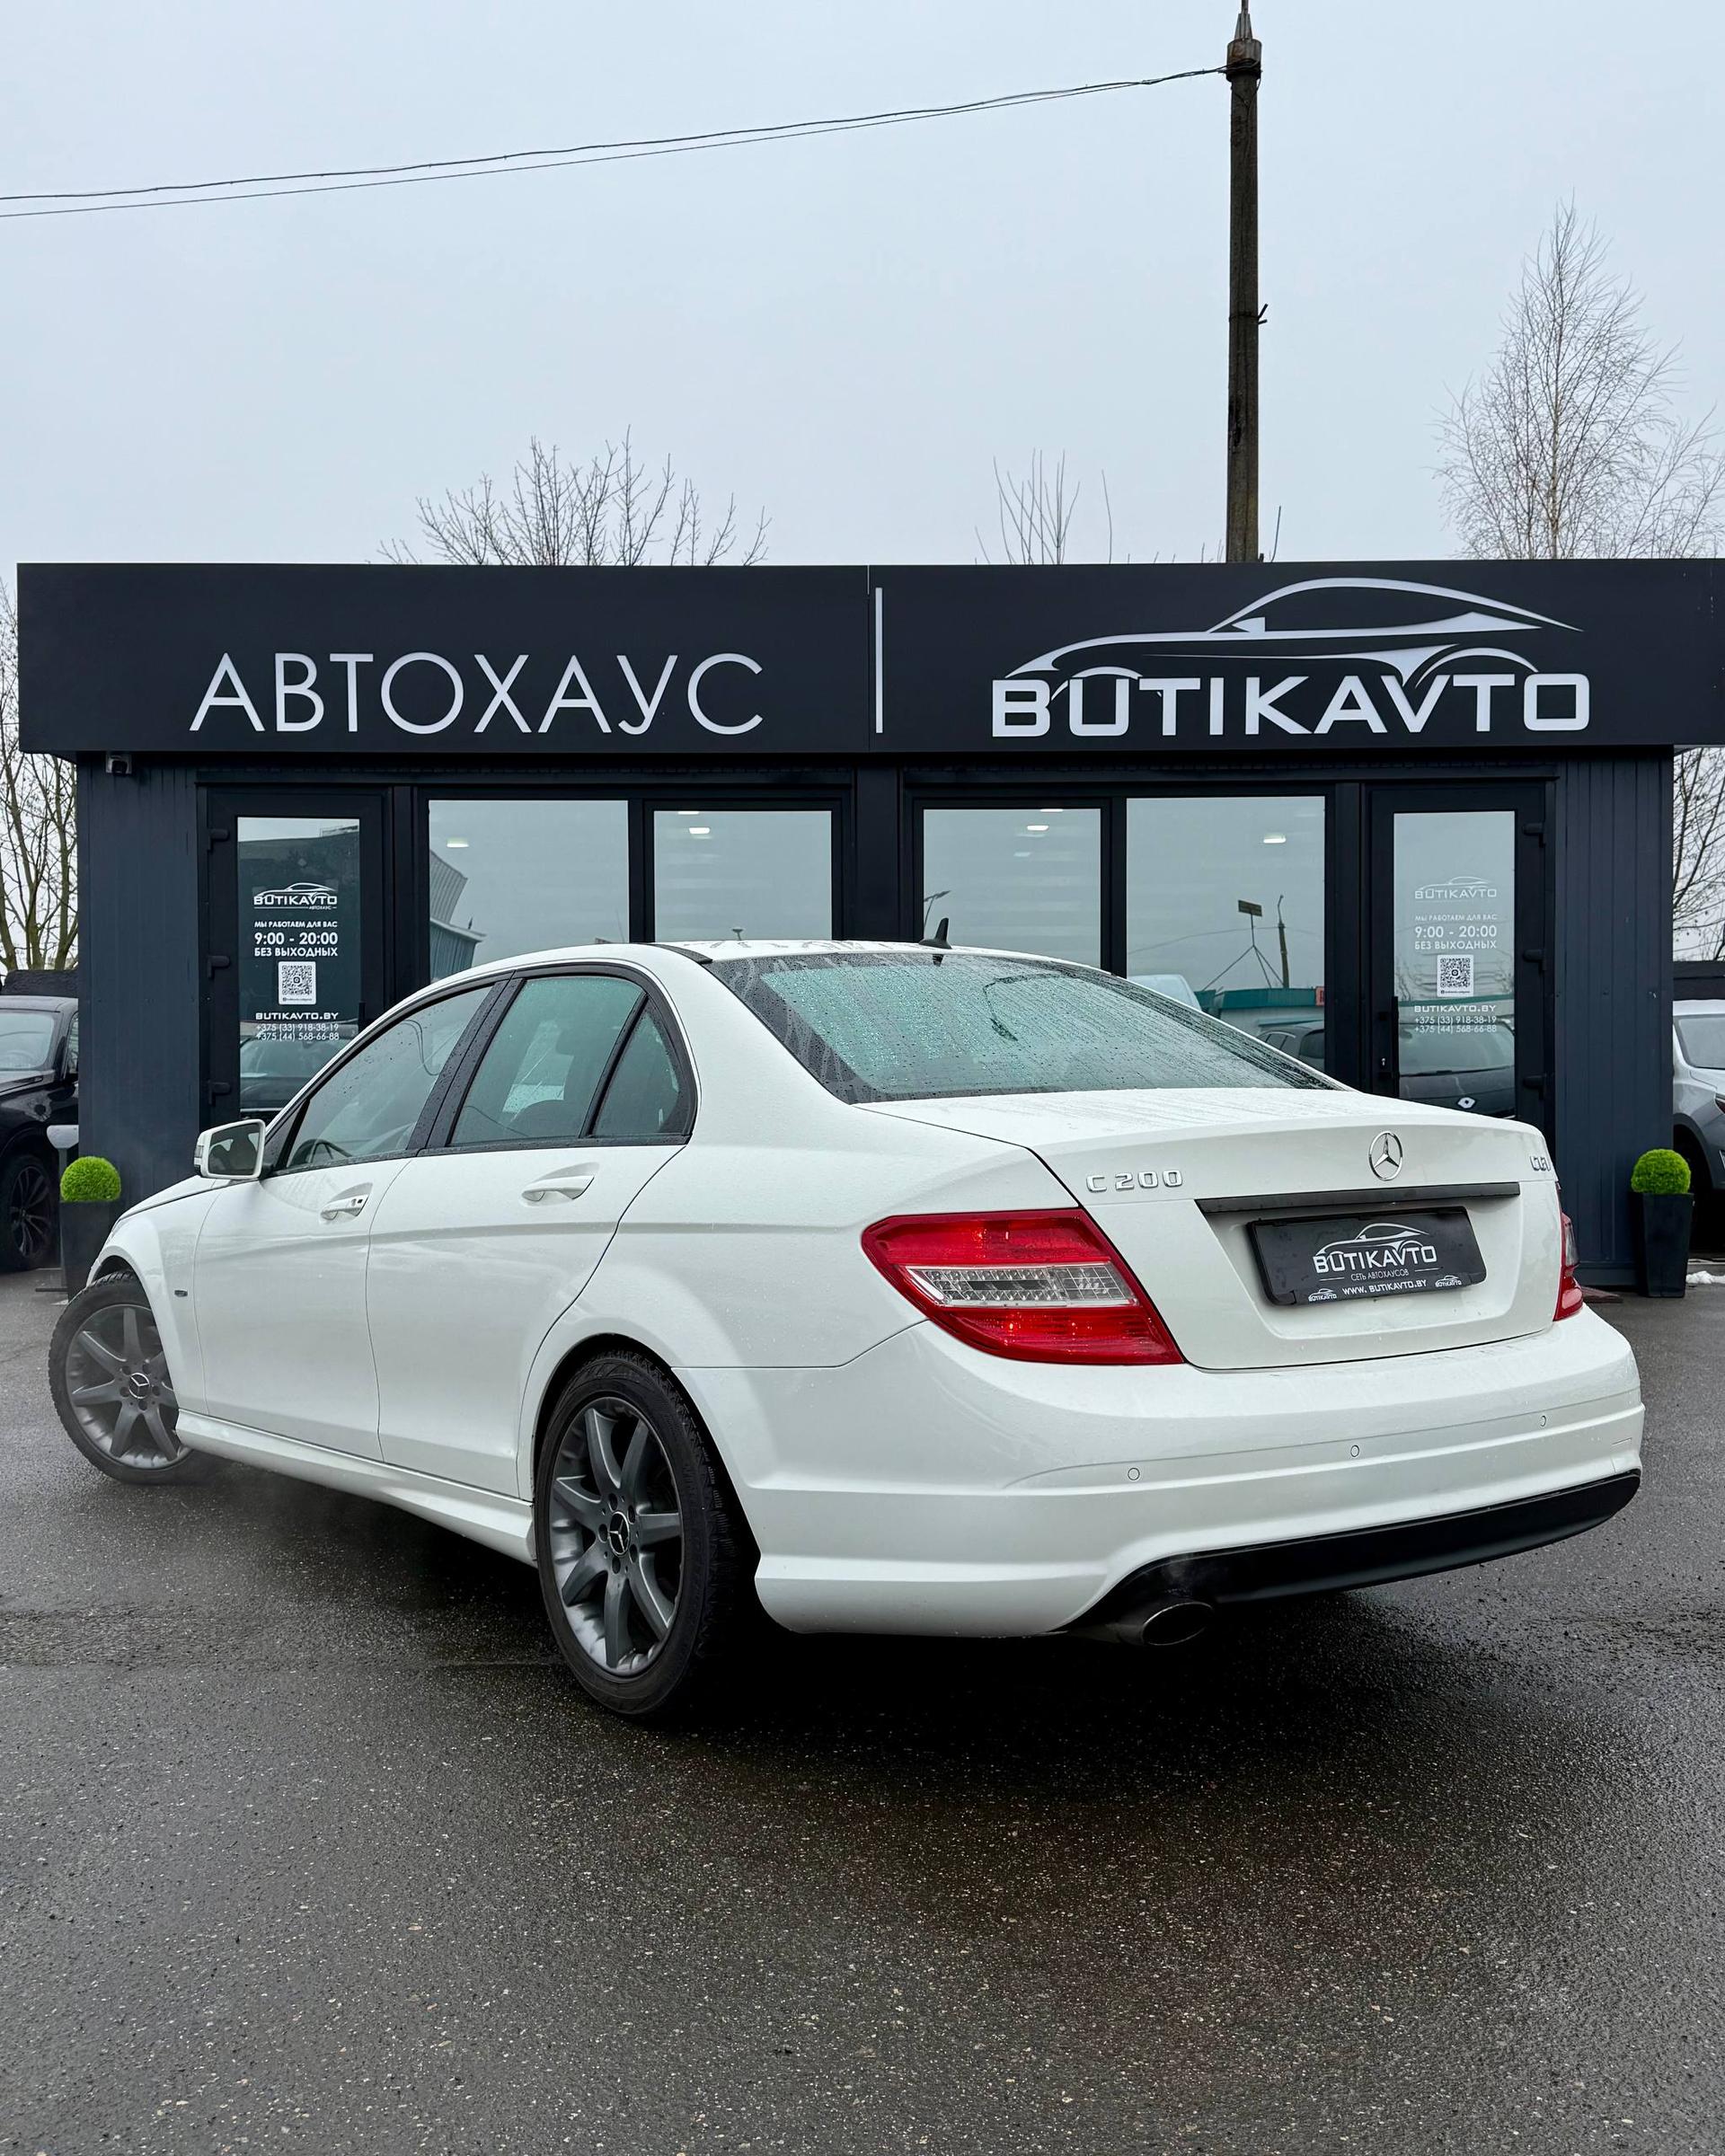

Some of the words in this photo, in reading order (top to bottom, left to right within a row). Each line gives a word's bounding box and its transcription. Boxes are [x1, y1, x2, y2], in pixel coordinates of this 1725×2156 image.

[190, 651, 764, 736] АВТОХАУС
[992, 672, 1589, 738] BUTIKAVTO
[1414, 888, 1497, 899] BUTIKAVTO
[253, 895, 338, 906] BUTIKAVTO
[1466, 914, 1482, 922] ДЛЯ
[306, 921, 322, 929] ДЛЯ
[1414, 925, 1444, 939] 9:00
[1458, 924, 1497, 938] 20:00
[254, 932, 285, 945] 9:00
[298, 932, 339, 945] 20:00
[1414, 941, 1431, 950] БЕЗ
[1434, 939, 1498, 950] ВЫХОДНЫХ
[254, 947, 272, 957] БЕЗ
[274, 947, 339, 958] ВЫХОДНЫХ
[1414, 1004, 1496, 1013] BUTIKAVTO.BY
[255, 1012, 339, 1021] BUTIKAVTO.BY
[1414, 1016, 1436, 1024] +375
[1438, 1016, 1453, 1025] (33)
[1455, 1015, 1497, 1024] 918-38-19
[255, 1023, 277, 1032] +375
[279, 1023, 295, 1033] (33)
[297, 1023, 339, 1032] 918-38-19
[1414, 1025, 1436, 1033] +375
[1438, 1025, 1453, 1034] (44)
[1455, 1024, 1497, 1033] 568-66-88
[279, 1032, 295, 1042] (44)
[298, 1032, 340, 1041] 568-66-88
[1086, 1175, 1107, 1194] C
[1115, 1170, 1184, 1192] 200
[1313, 1245, 1438, 1274] BUTIKAVTO
[1350, 1272, 1367, 1281] СЕТЬ
[1367, 1268, 1410, 1280] АВТОХАУСОВ
[1368, 1279, 1428, 1294] BUTIKAVTO.BY
